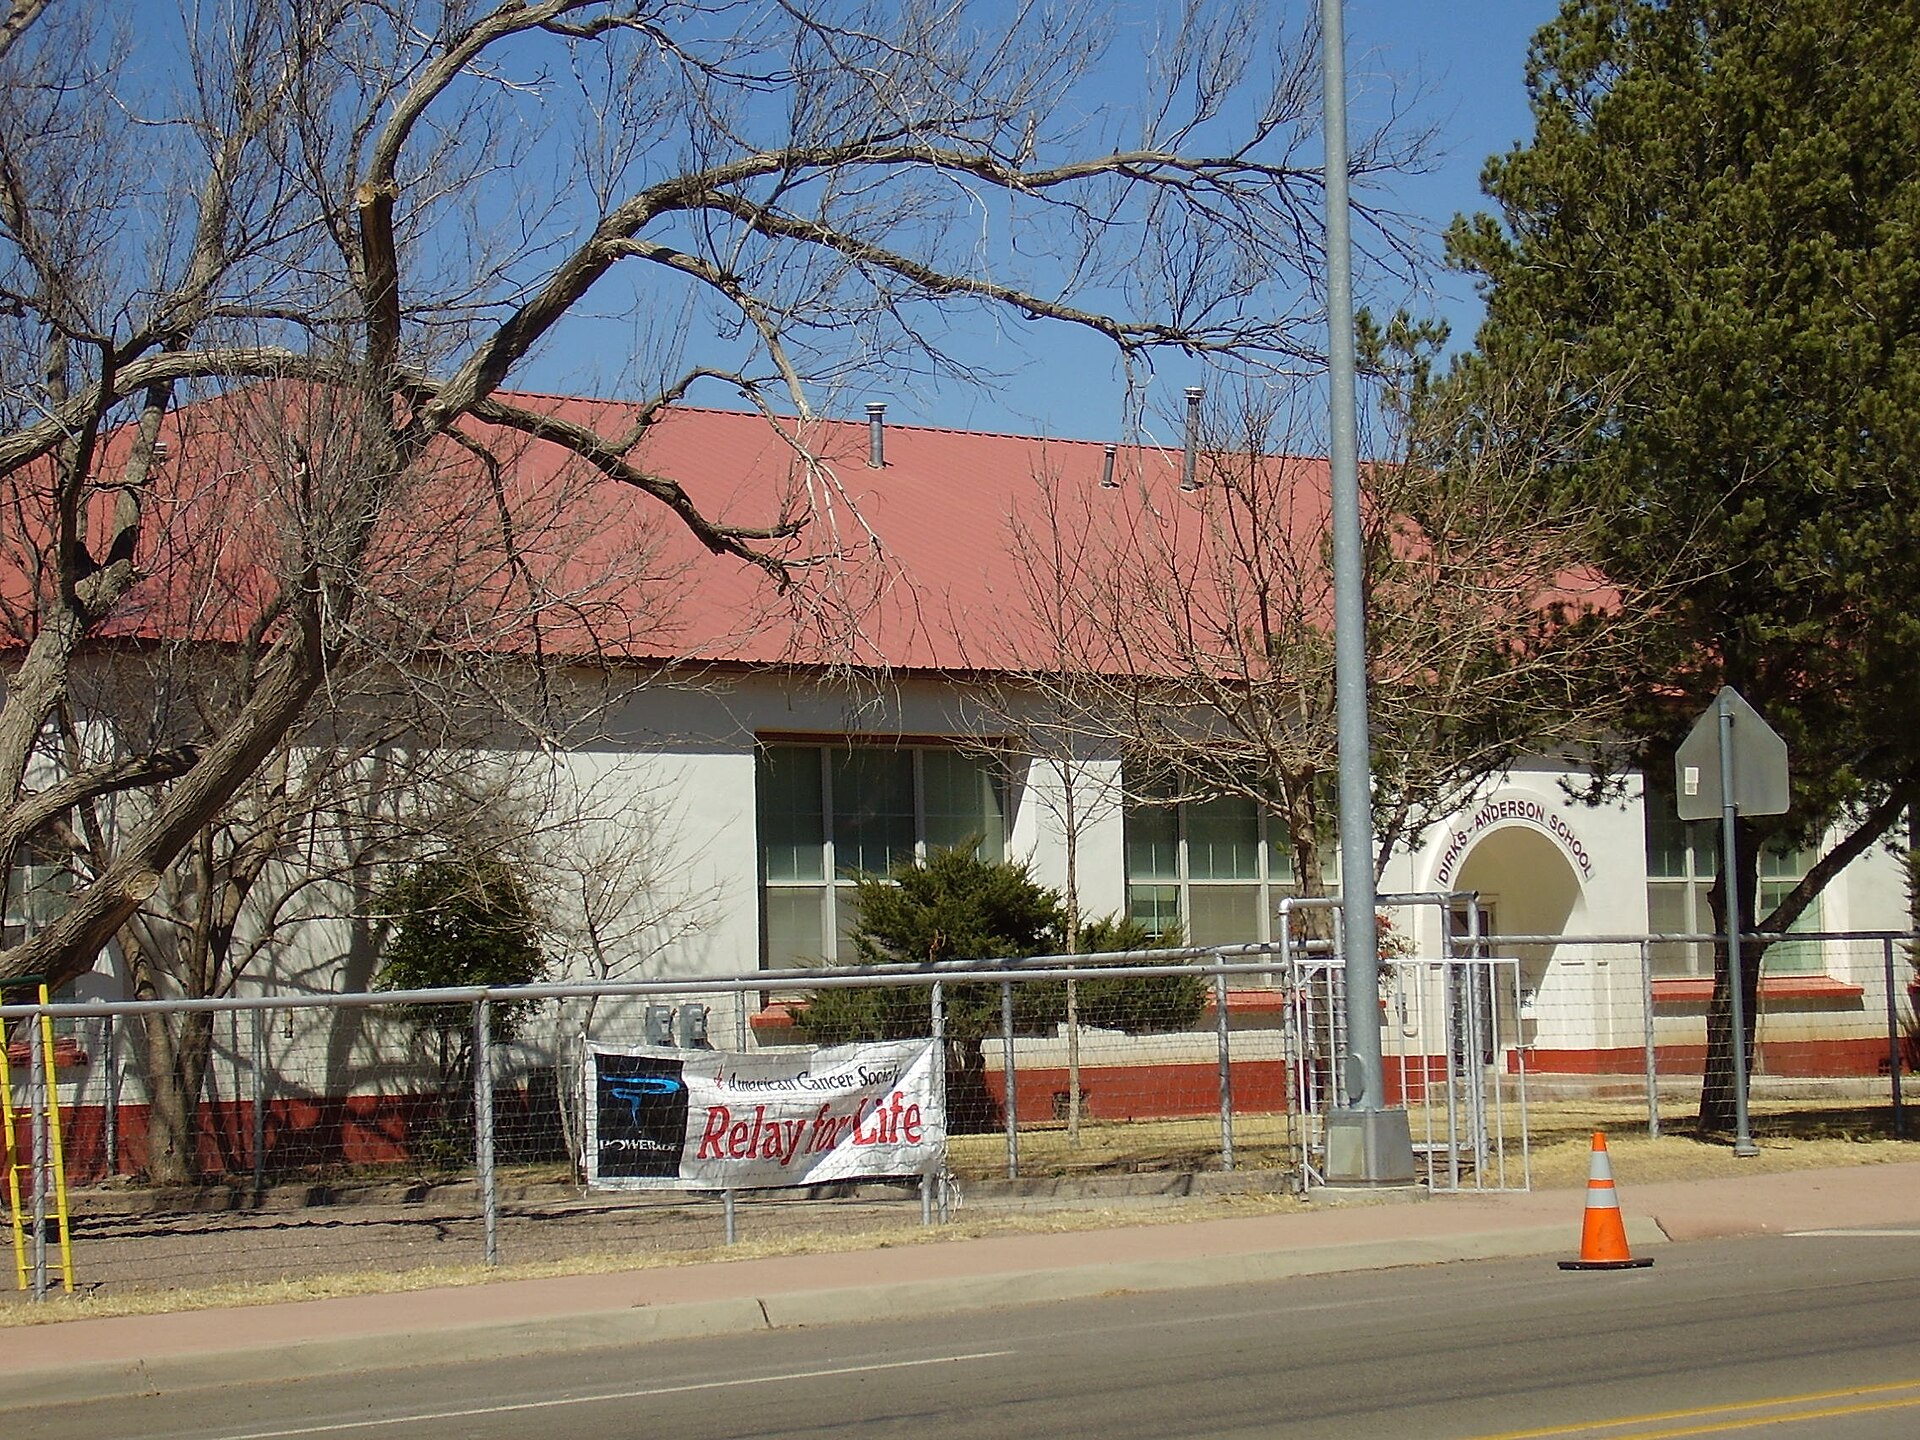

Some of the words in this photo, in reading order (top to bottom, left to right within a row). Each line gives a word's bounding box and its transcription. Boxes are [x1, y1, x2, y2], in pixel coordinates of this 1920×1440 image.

[1549, 814, 1594, 878] SCHOOL
[728, 1071, 796, 1092] American
[797, 1070, 854, 1091] Cancer
[697, 1105, 806, 1166] Relay
[804, 1103, 852, 1154] for
[852, 1091, 922, 1146] Life
